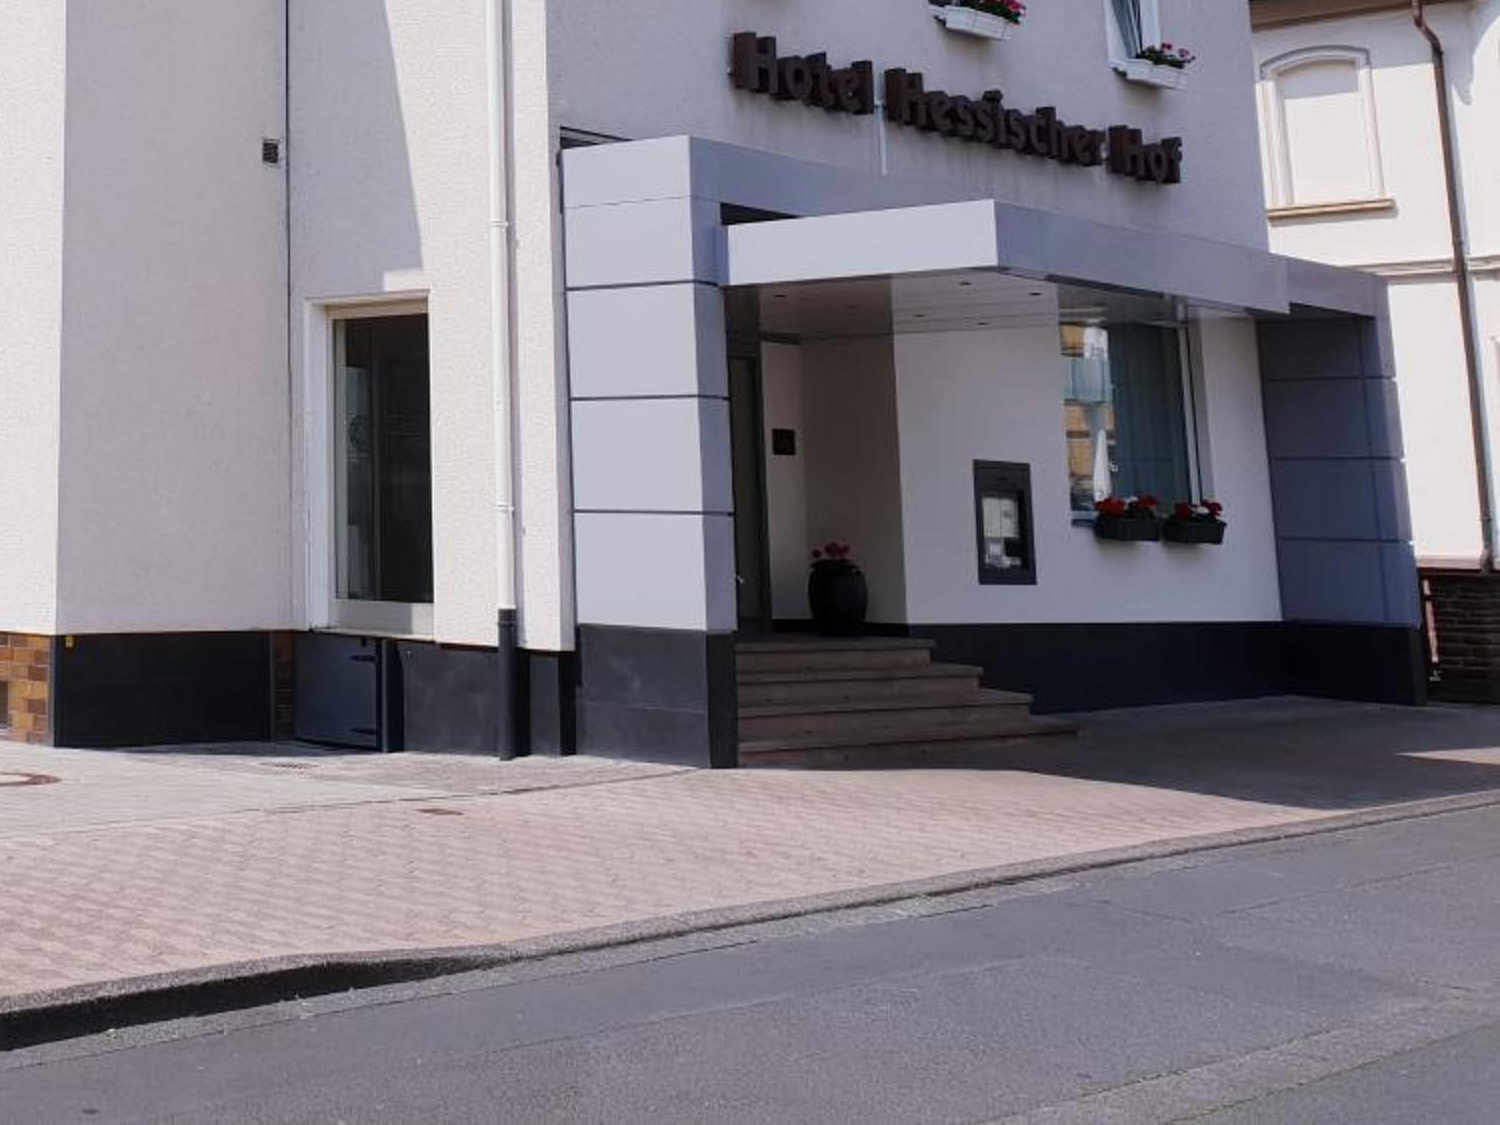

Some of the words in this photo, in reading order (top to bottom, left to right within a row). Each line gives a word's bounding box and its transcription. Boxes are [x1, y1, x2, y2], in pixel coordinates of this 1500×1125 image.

[732, 32, 874, 115] Hotel
[884, 68, 1106, 167] Hessischer
[1106, 125, 1183, 184] Hof
